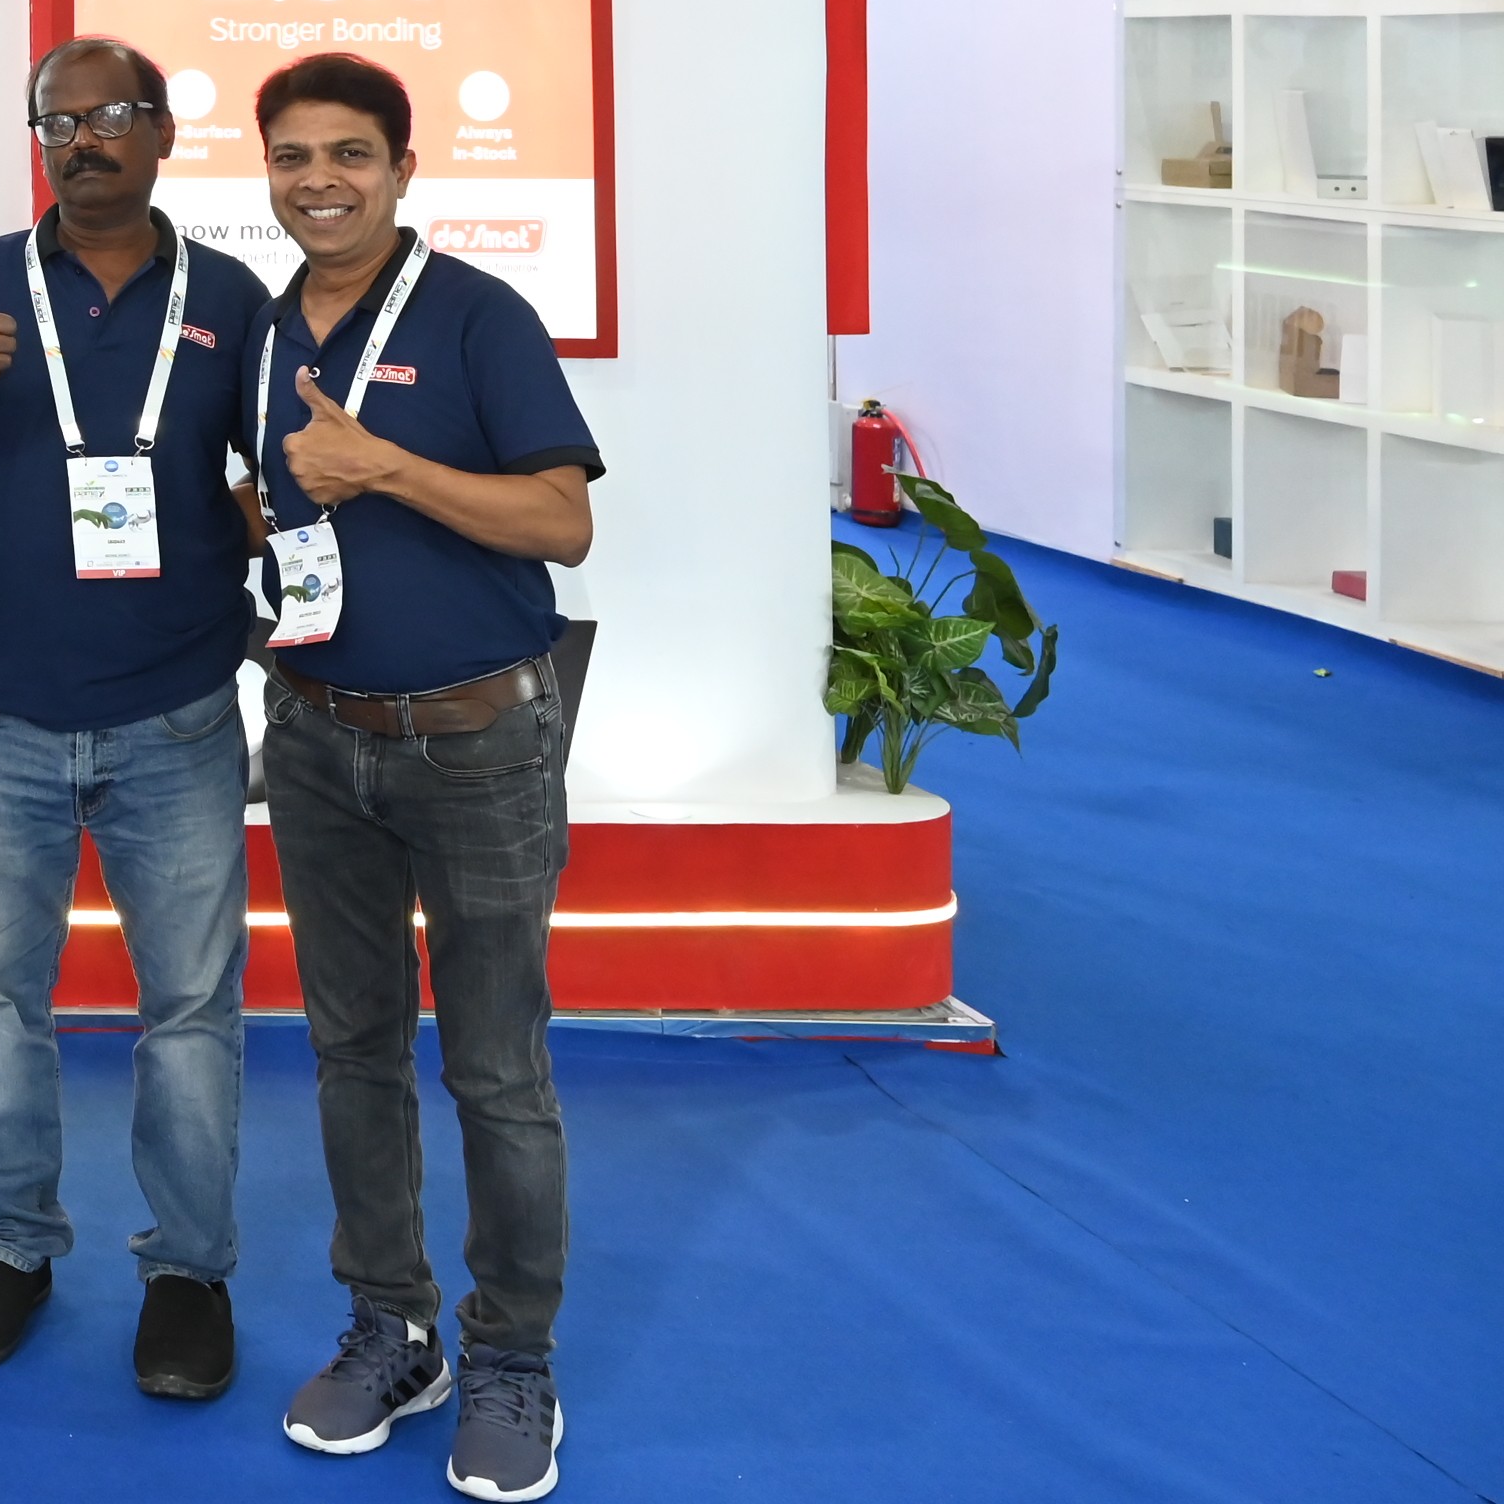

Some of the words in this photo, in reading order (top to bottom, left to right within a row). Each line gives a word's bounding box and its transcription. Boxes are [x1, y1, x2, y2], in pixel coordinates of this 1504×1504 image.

[209, 16, 323, 50] Stronger
[331, 16, 442, 50] Bonding
[175, 224, 230, 241] now
[112, 569, 126, 577] VIP
